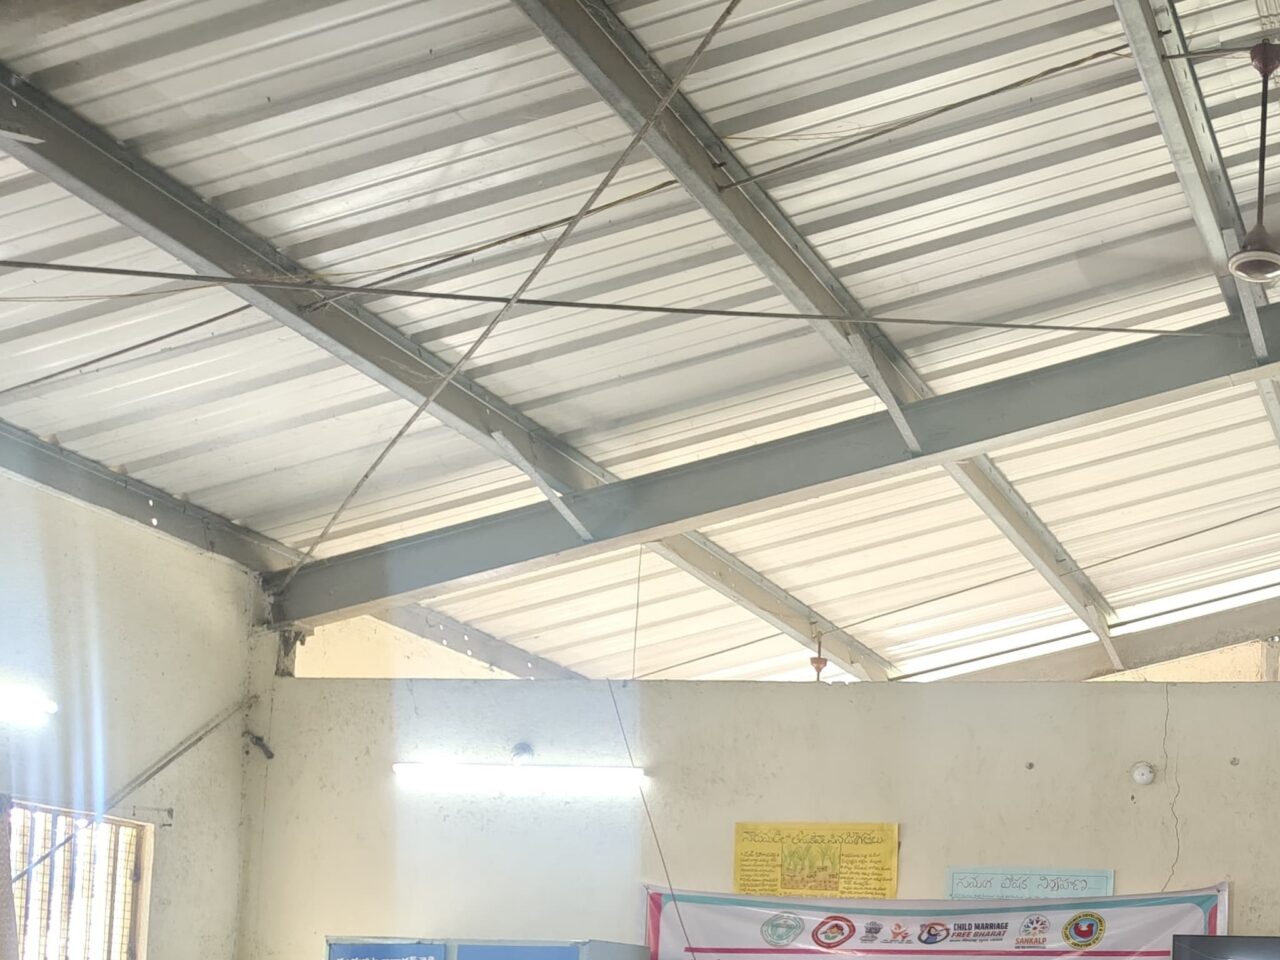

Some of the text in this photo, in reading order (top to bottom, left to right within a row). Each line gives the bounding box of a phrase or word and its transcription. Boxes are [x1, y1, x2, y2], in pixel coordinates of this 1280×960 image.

[954, 922, 1008, 931] CHILD MARRIAGE
[1015, 937, 1047, 945] SANKALP
